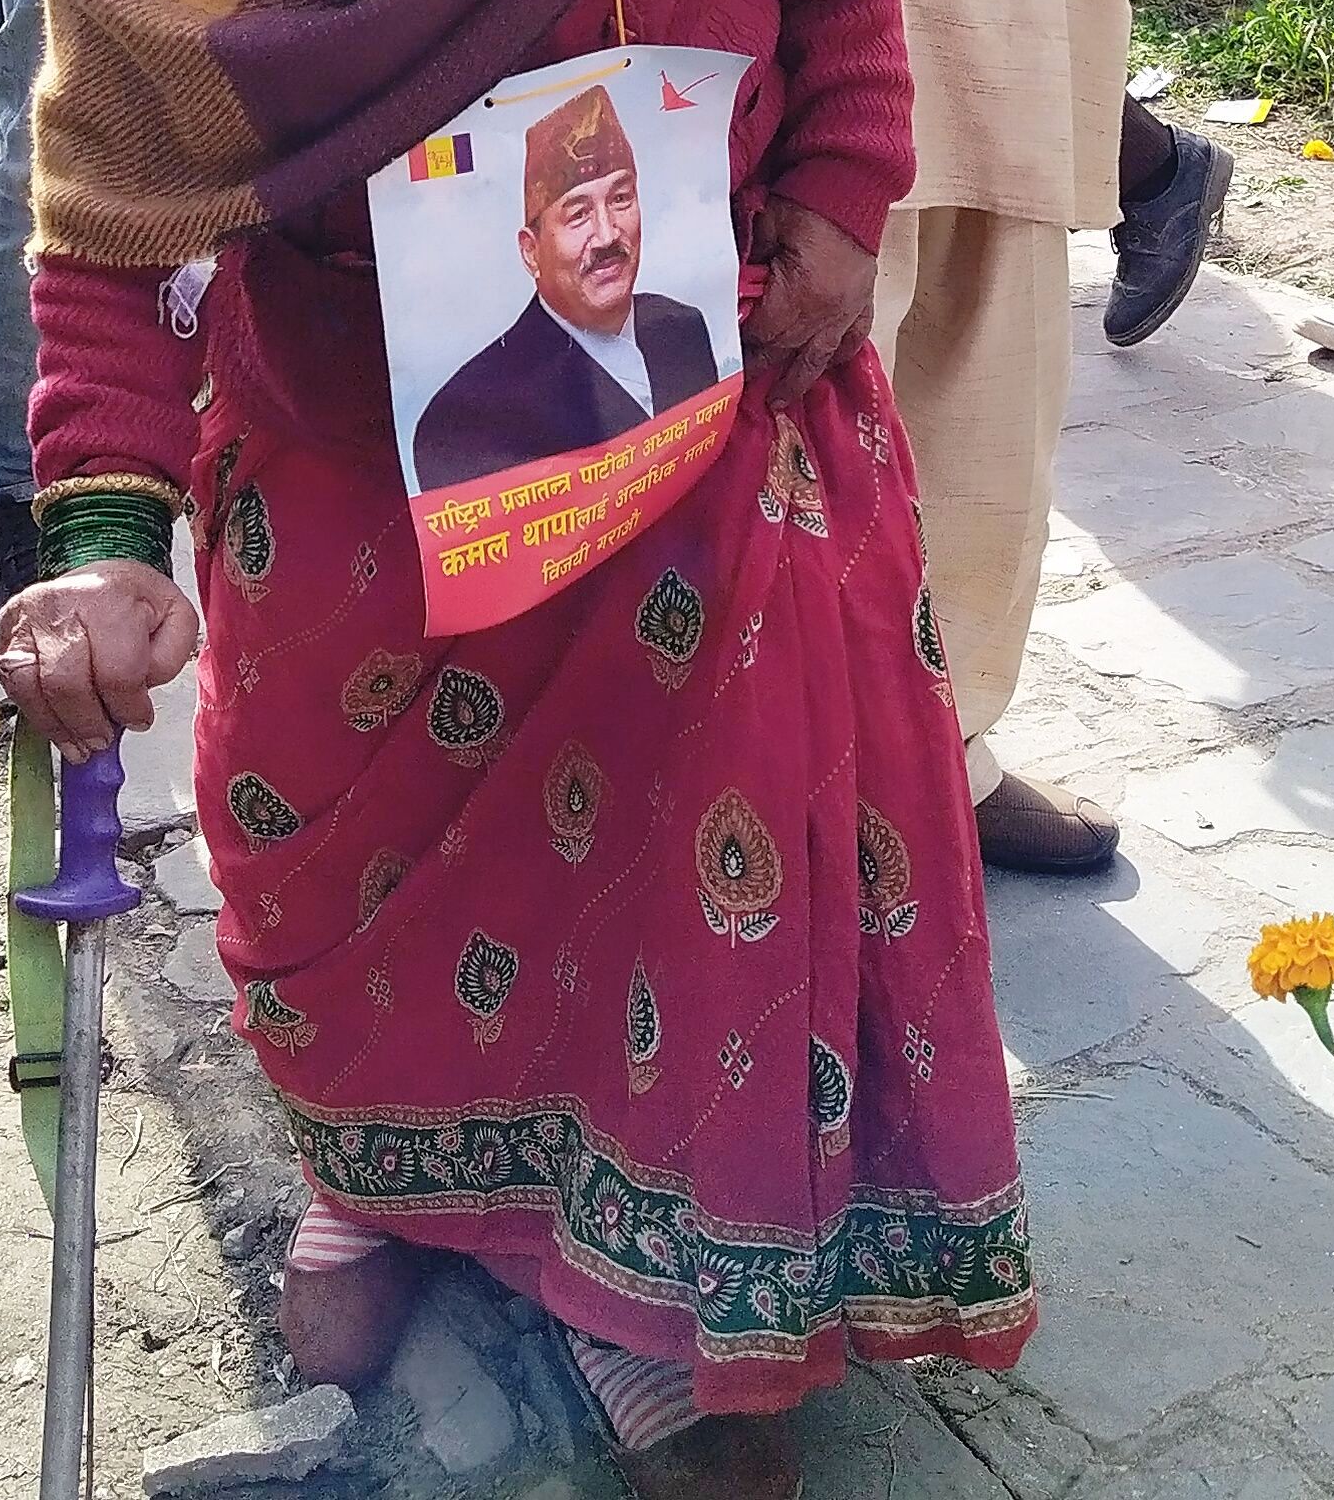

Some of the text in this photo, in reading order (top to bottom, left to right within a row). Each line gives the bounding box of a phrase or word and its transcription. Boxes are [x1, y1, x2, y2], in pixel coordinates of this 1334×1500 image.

[424, 499, 492, 537] राष्ट्रिय
[498, 472, 572, 515] प्रजातन्त्र
[642, 417, 690, 457] अध्यक्ष
[438, 531, 511, 577] कमल
[617, 456, 680, 507] अत्यधिक
[541, 540, 591, 585] विजयी
